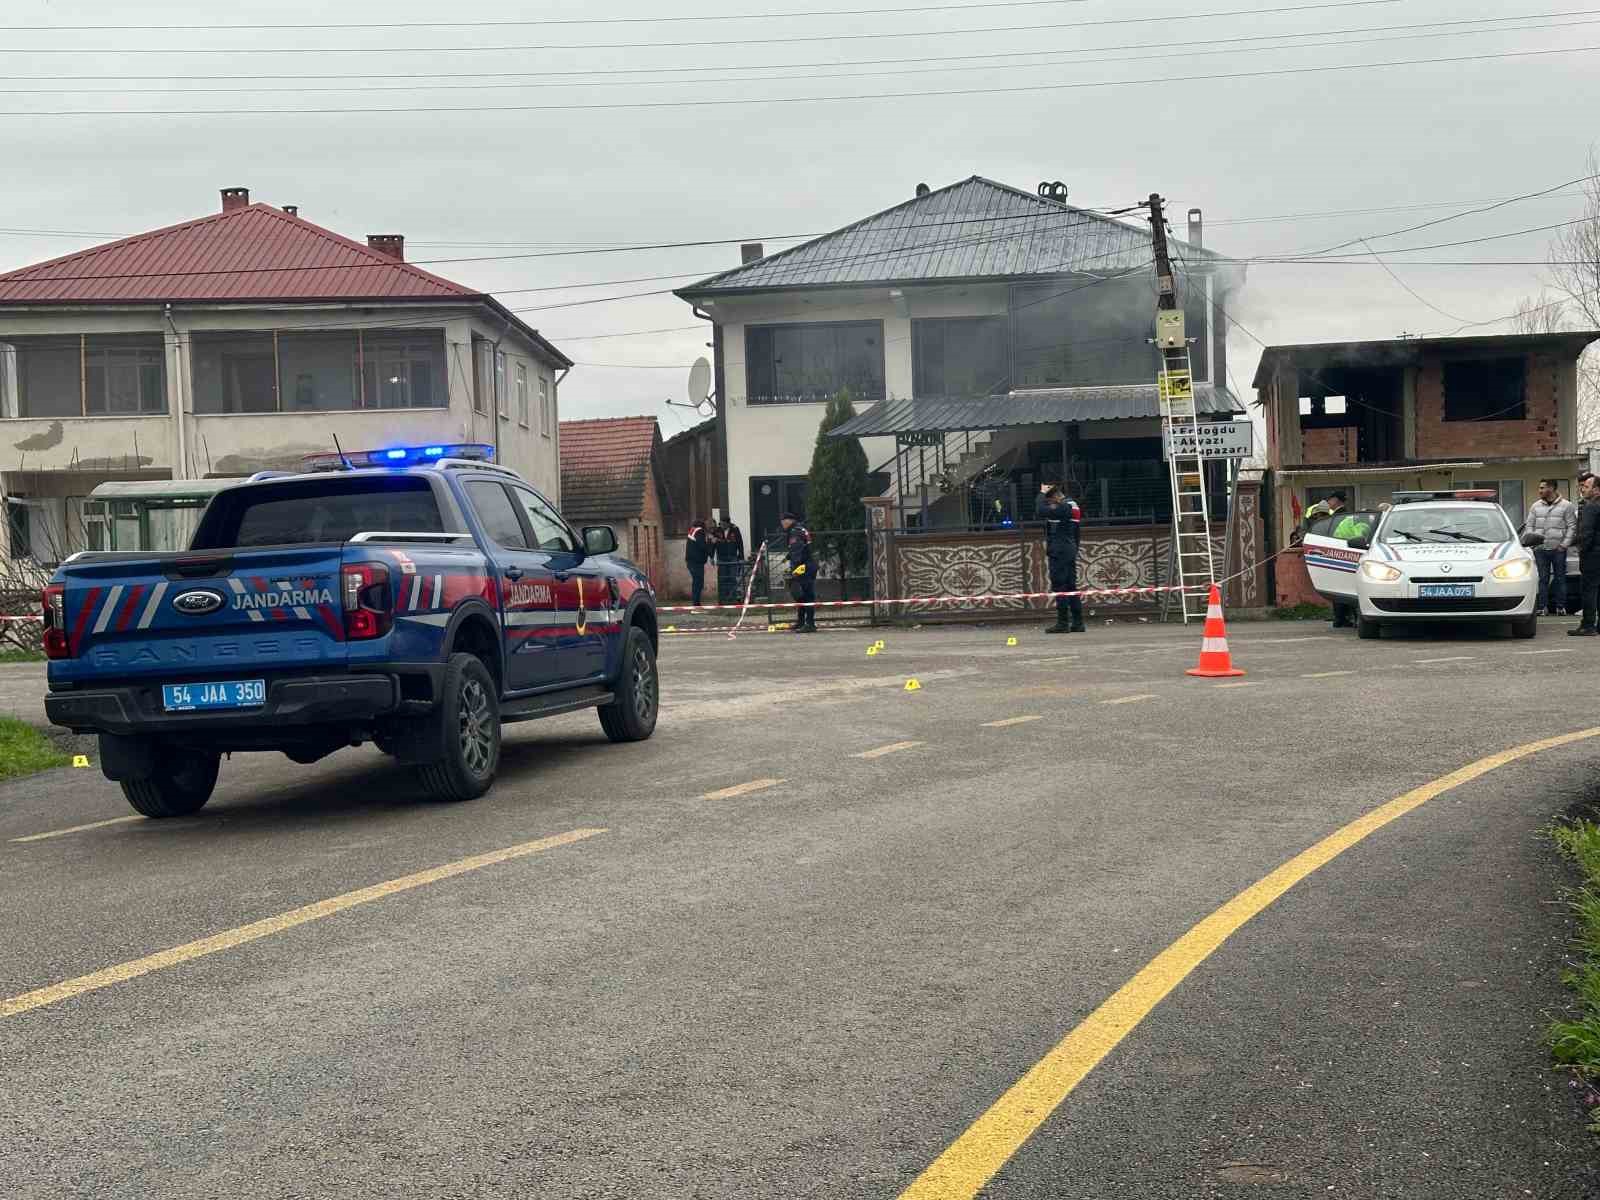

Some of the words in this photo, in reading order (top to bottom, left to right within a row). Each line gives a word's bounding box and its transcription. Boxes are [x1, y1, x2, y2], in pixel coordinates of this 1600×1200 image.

[1327, 549, 1360, 562] JANDARM
[231, 588, 334, 611] JANDARMA
[511, 584, 552, 605] JANDARMA
[173, 686, 192, 704] 54
[200, 684, 228, 704] JAA
[235, 682, 264, 701] 350
